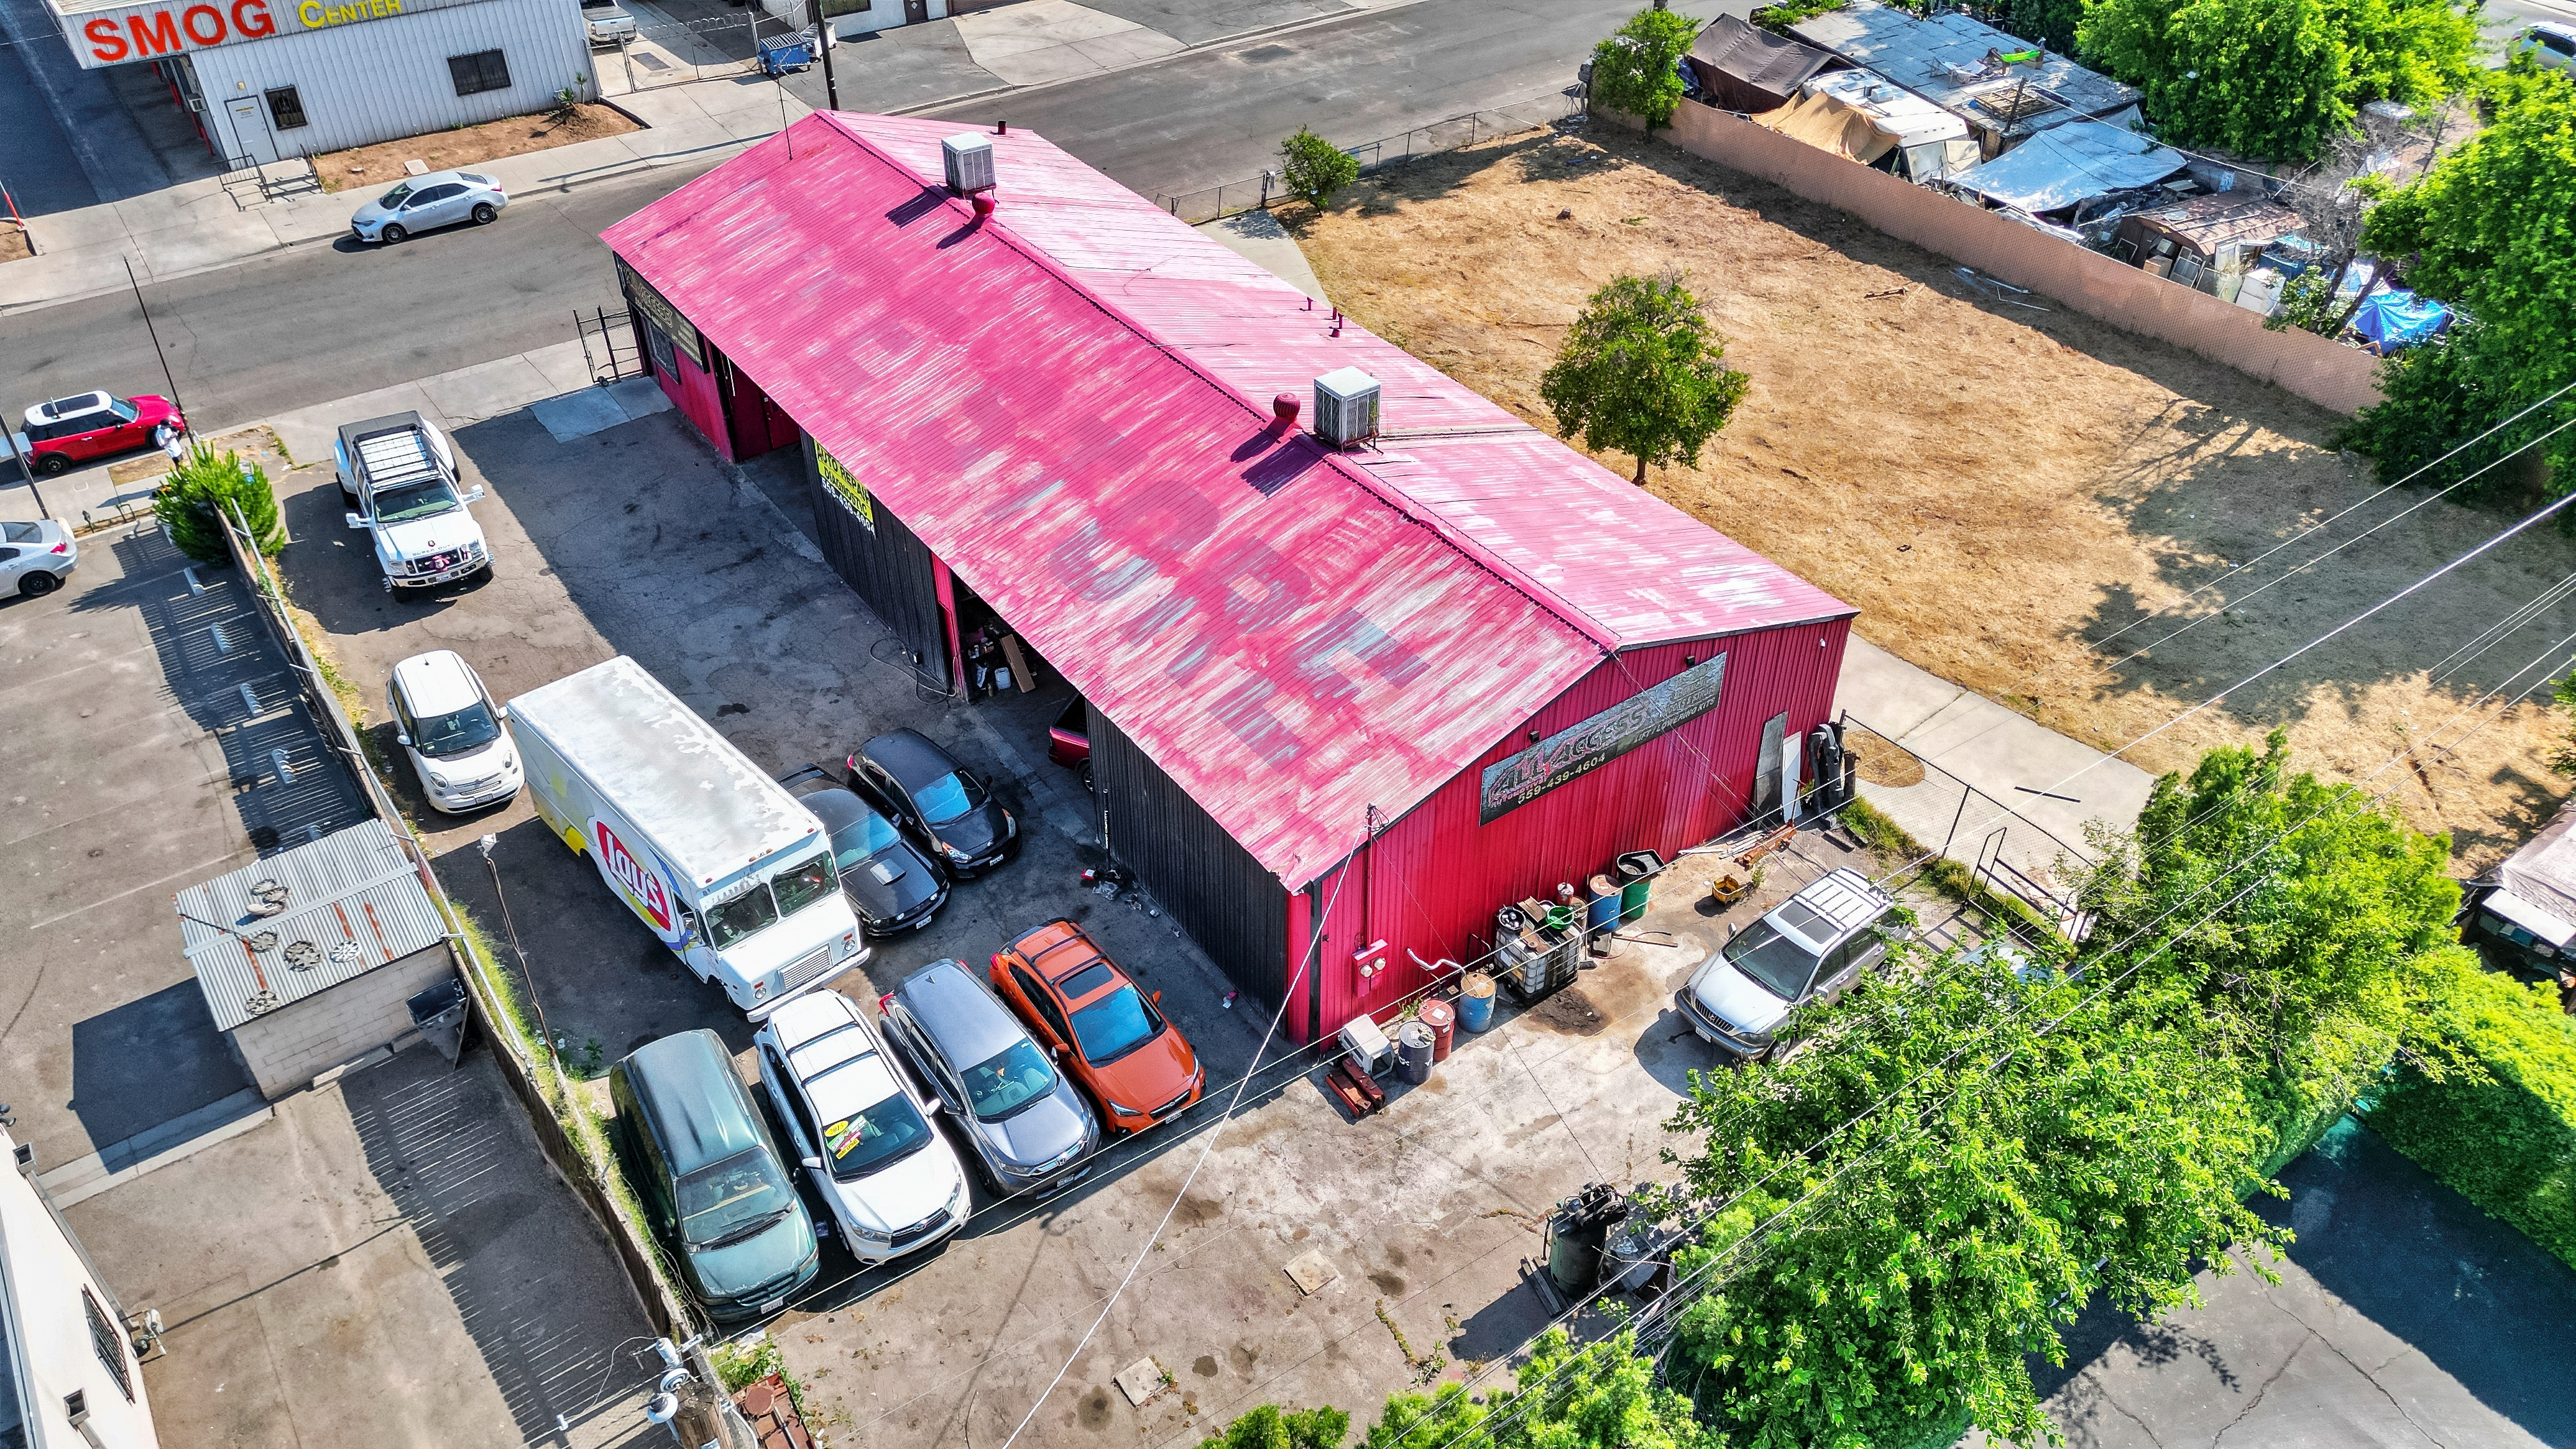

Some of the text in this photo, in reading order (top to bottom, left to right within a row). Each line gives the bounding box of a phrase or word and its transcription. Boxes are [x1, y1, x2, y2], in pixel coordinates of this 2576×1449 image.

[84, 0, 402, 61] SMOG CENTER
[816, 443, 838, 471] AUTO
[824, 466, 868, 516] DIAGNOSTIC
[1697, 697, 1716, 714] KITS
[1551, 706, 1647, 767] ACCESS
[1517, 752, 1606, 804] 559-439-4604
[606, 831, 664, 915] Lay's
[829, 1122, 845, 1135] 2015
